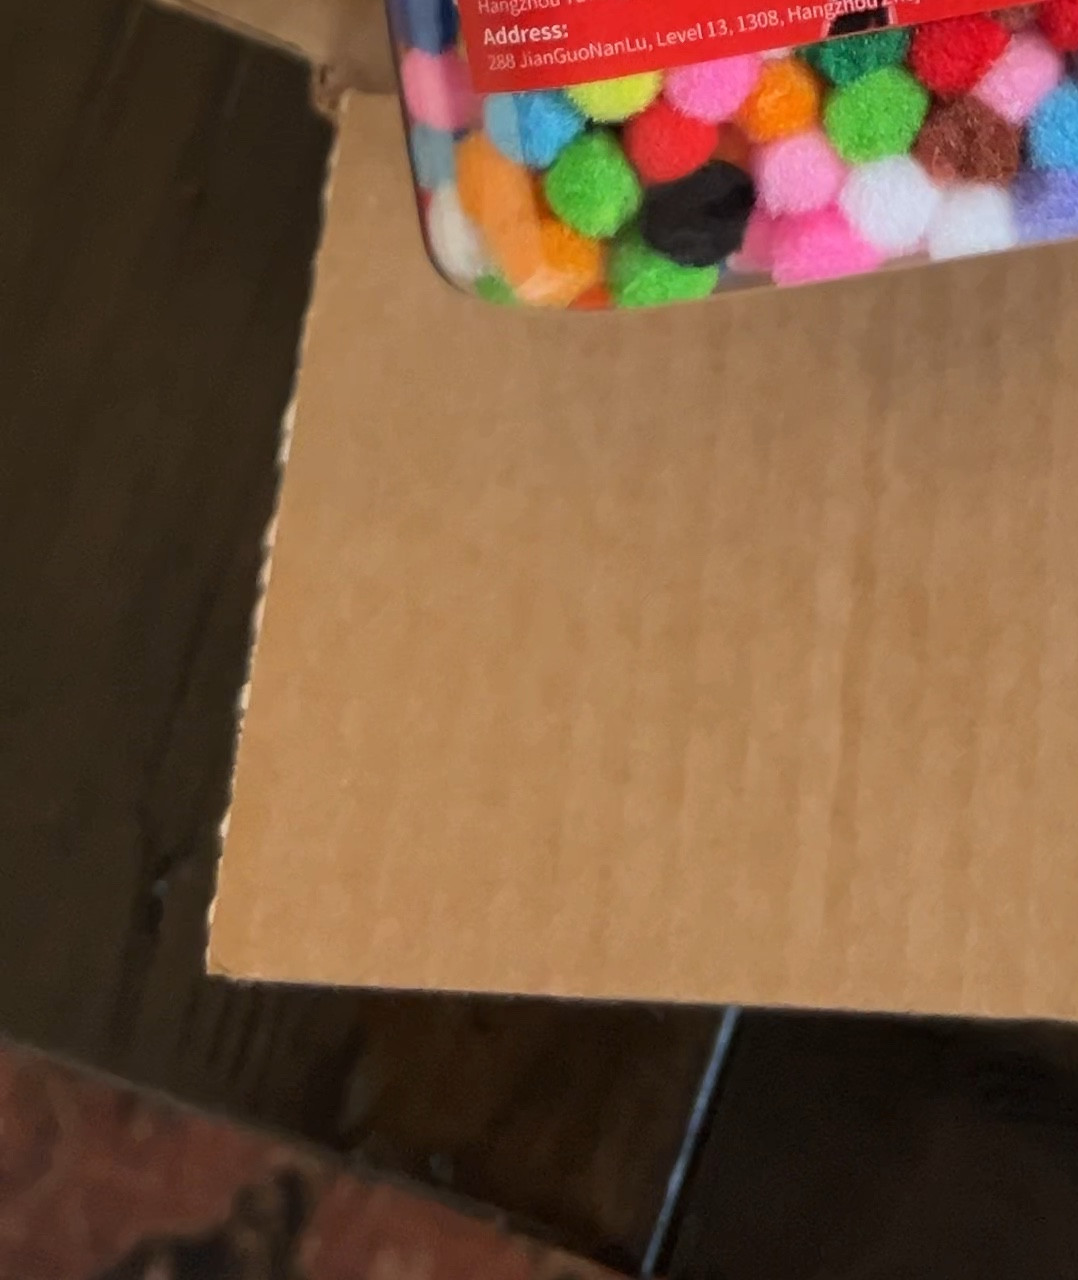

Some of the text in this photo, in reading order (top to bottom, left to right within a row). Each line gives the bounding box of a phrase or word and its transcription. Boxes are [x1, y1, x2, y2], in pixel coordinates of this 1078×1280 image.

[484, 23, 569, 46] Address:
[487, 52, 516, 71] 288
[519, 38, 654, 70] JianGuoNanLu,
[656, 25, 703, 48] Level
[707, 19, 734, 39] 13,
[737, 10, 785, 33] 1308,
